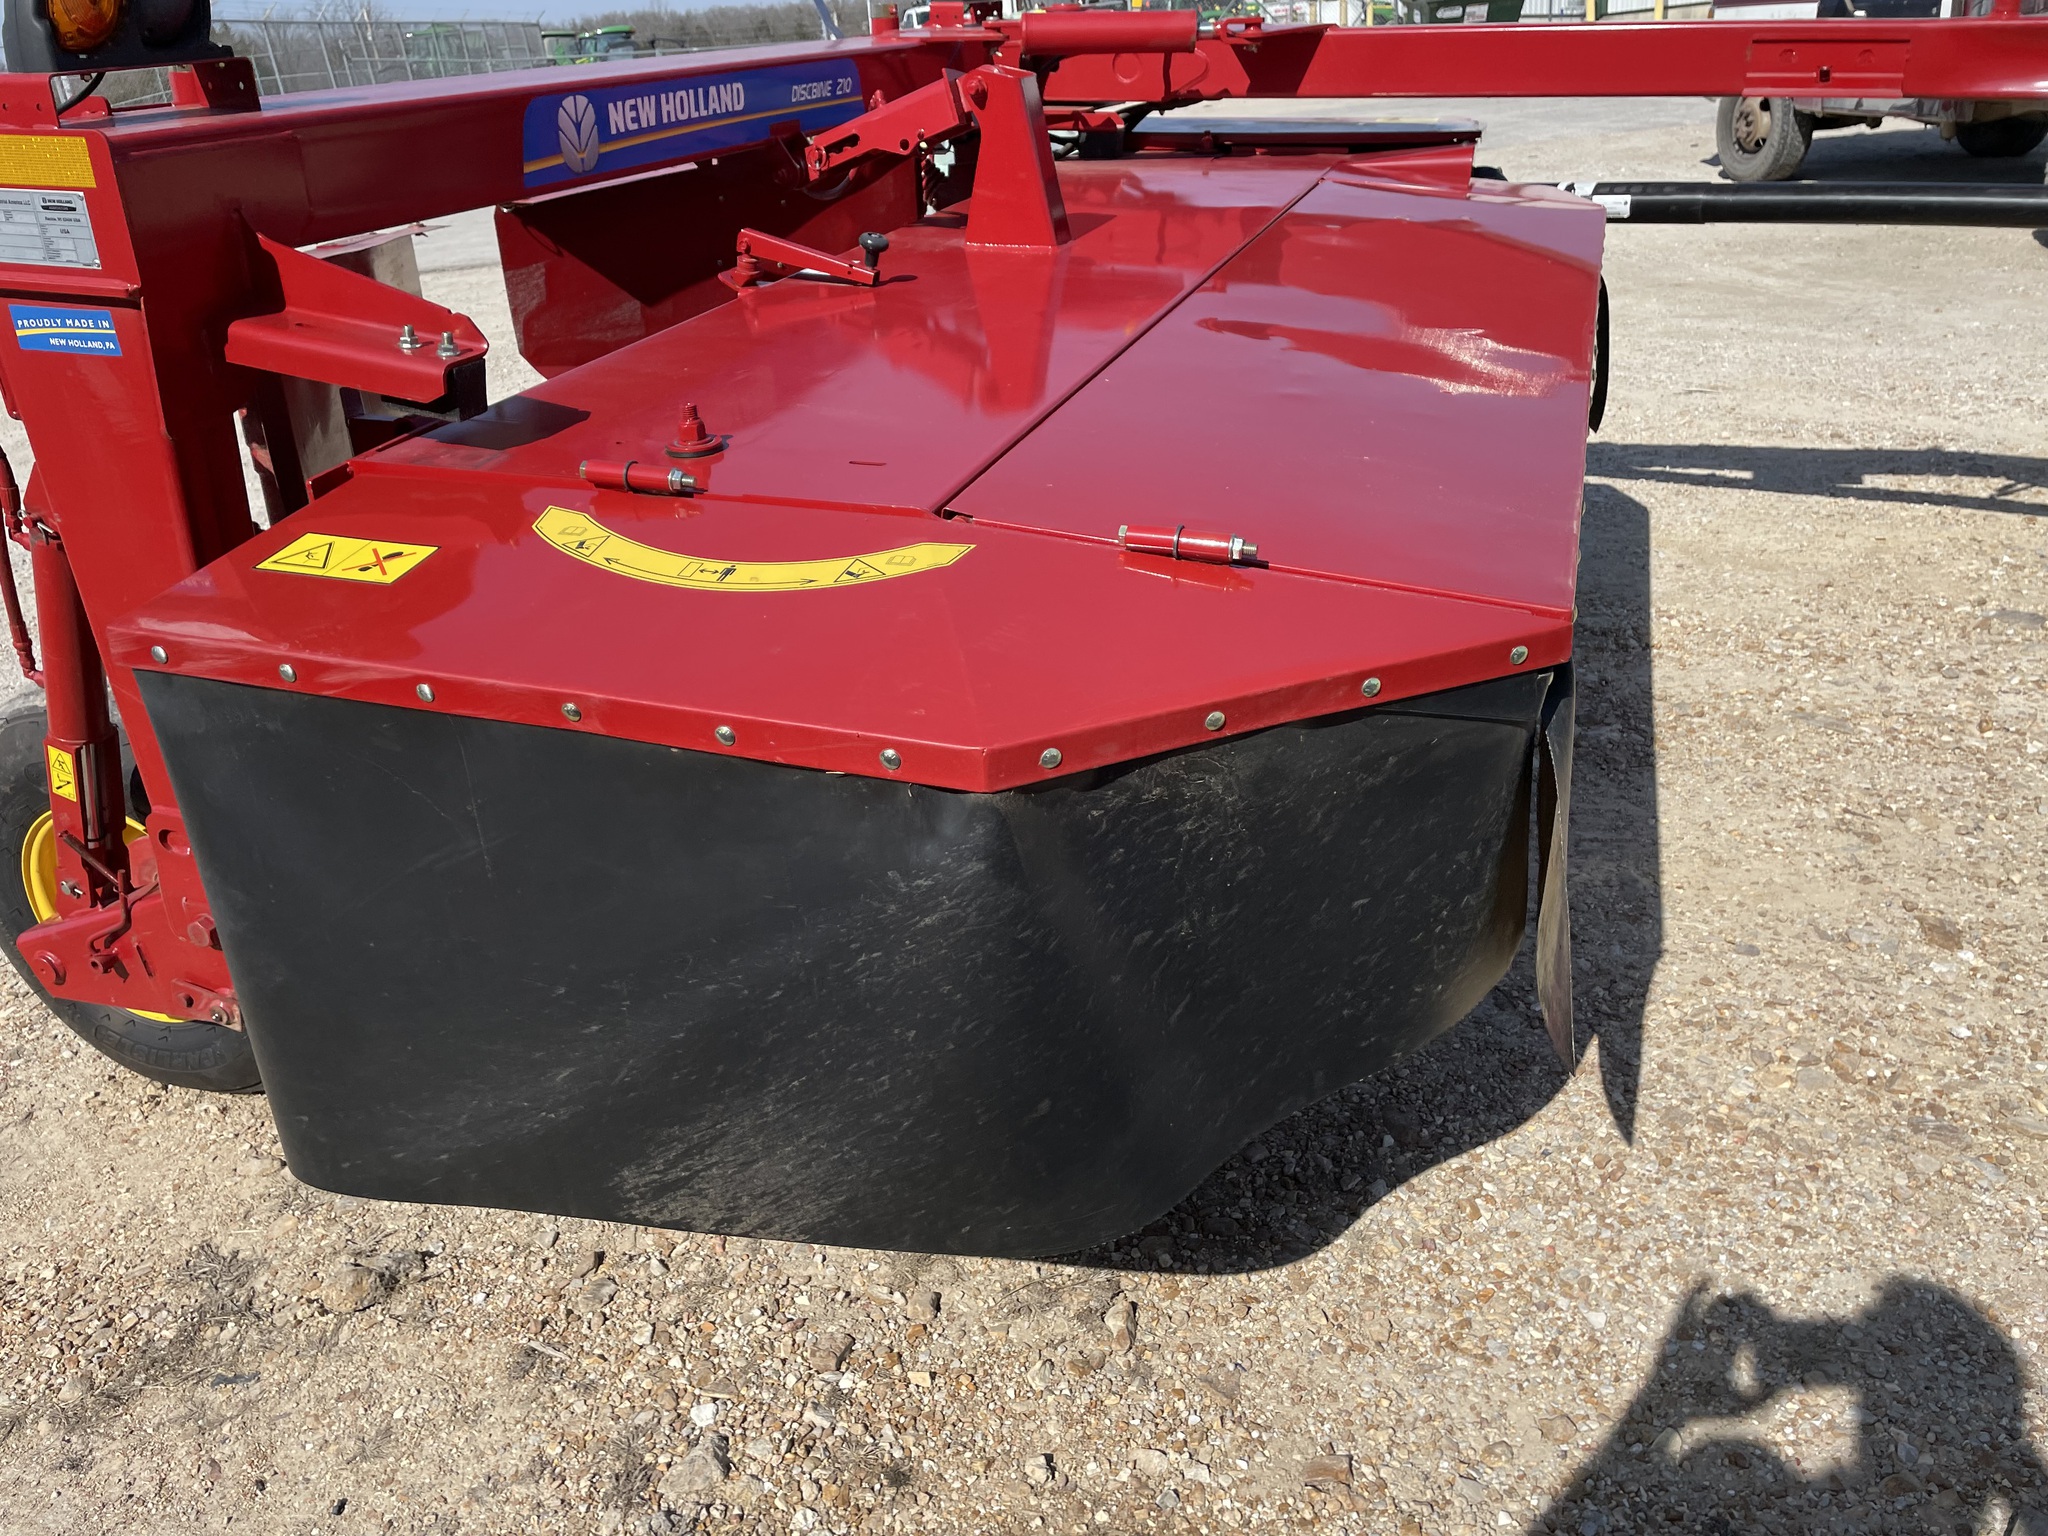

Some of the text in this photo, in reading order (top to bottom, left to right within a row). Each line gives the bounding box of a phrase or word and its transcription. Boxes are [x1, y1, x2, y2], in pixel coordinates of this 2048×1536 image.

[791, 77, 852, 102] DISCBINE 210
[607, 82, 745, 135] NEW HOLLAND
[17, 318, 110, 329] PROUDLY MADE IN
[49, 337, 66, 346] NEW
